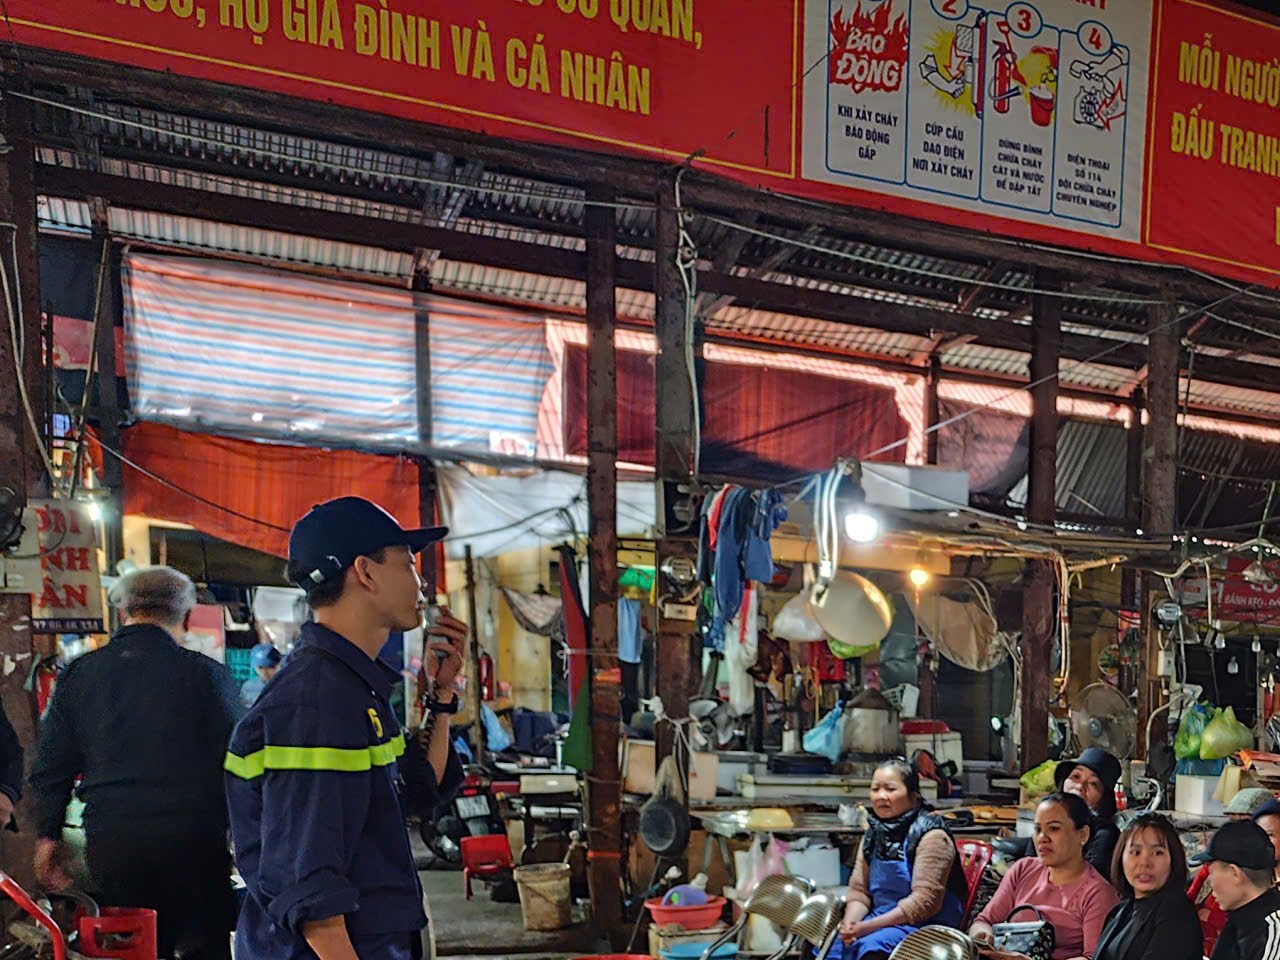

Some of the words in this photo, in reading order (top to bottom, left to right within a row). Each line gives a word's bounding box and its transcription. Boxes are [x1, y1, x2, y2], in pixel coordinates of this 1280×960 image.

[1017, 9, 1031, 32] 3
[845, 27, 886, 55] BÁO
[1088, 27, 1102, 50] 4
[282, 0, 344, 50] GIA
[354, 0, 440, 70] ĐÌNH
[450, 19, 495, 82] VÀ
[506, 33, 551, 93] CÁ
[560, 50, 650, 115] NHÂN
[1178, 32, 1220, 92] MỖI
[836, 52, 900, 92] ĐỘNG
[838, 104, 852, 118] KHI
[875, 112, 898, 127] CHÁY
[845, 124, 863, 139] BÁO
[866, 128, 890, 144] ĐỘNG
[925, 121, 943, 136] CÚP
[1171, 103, 1215, 160] ĐẤU
[923, 141, 941, 155] DAO
[944, 145, 964, 162] ĐIỆN
[913, 157, 928, 171] NƠI
[951, 166, 973, 180] CHÁY
